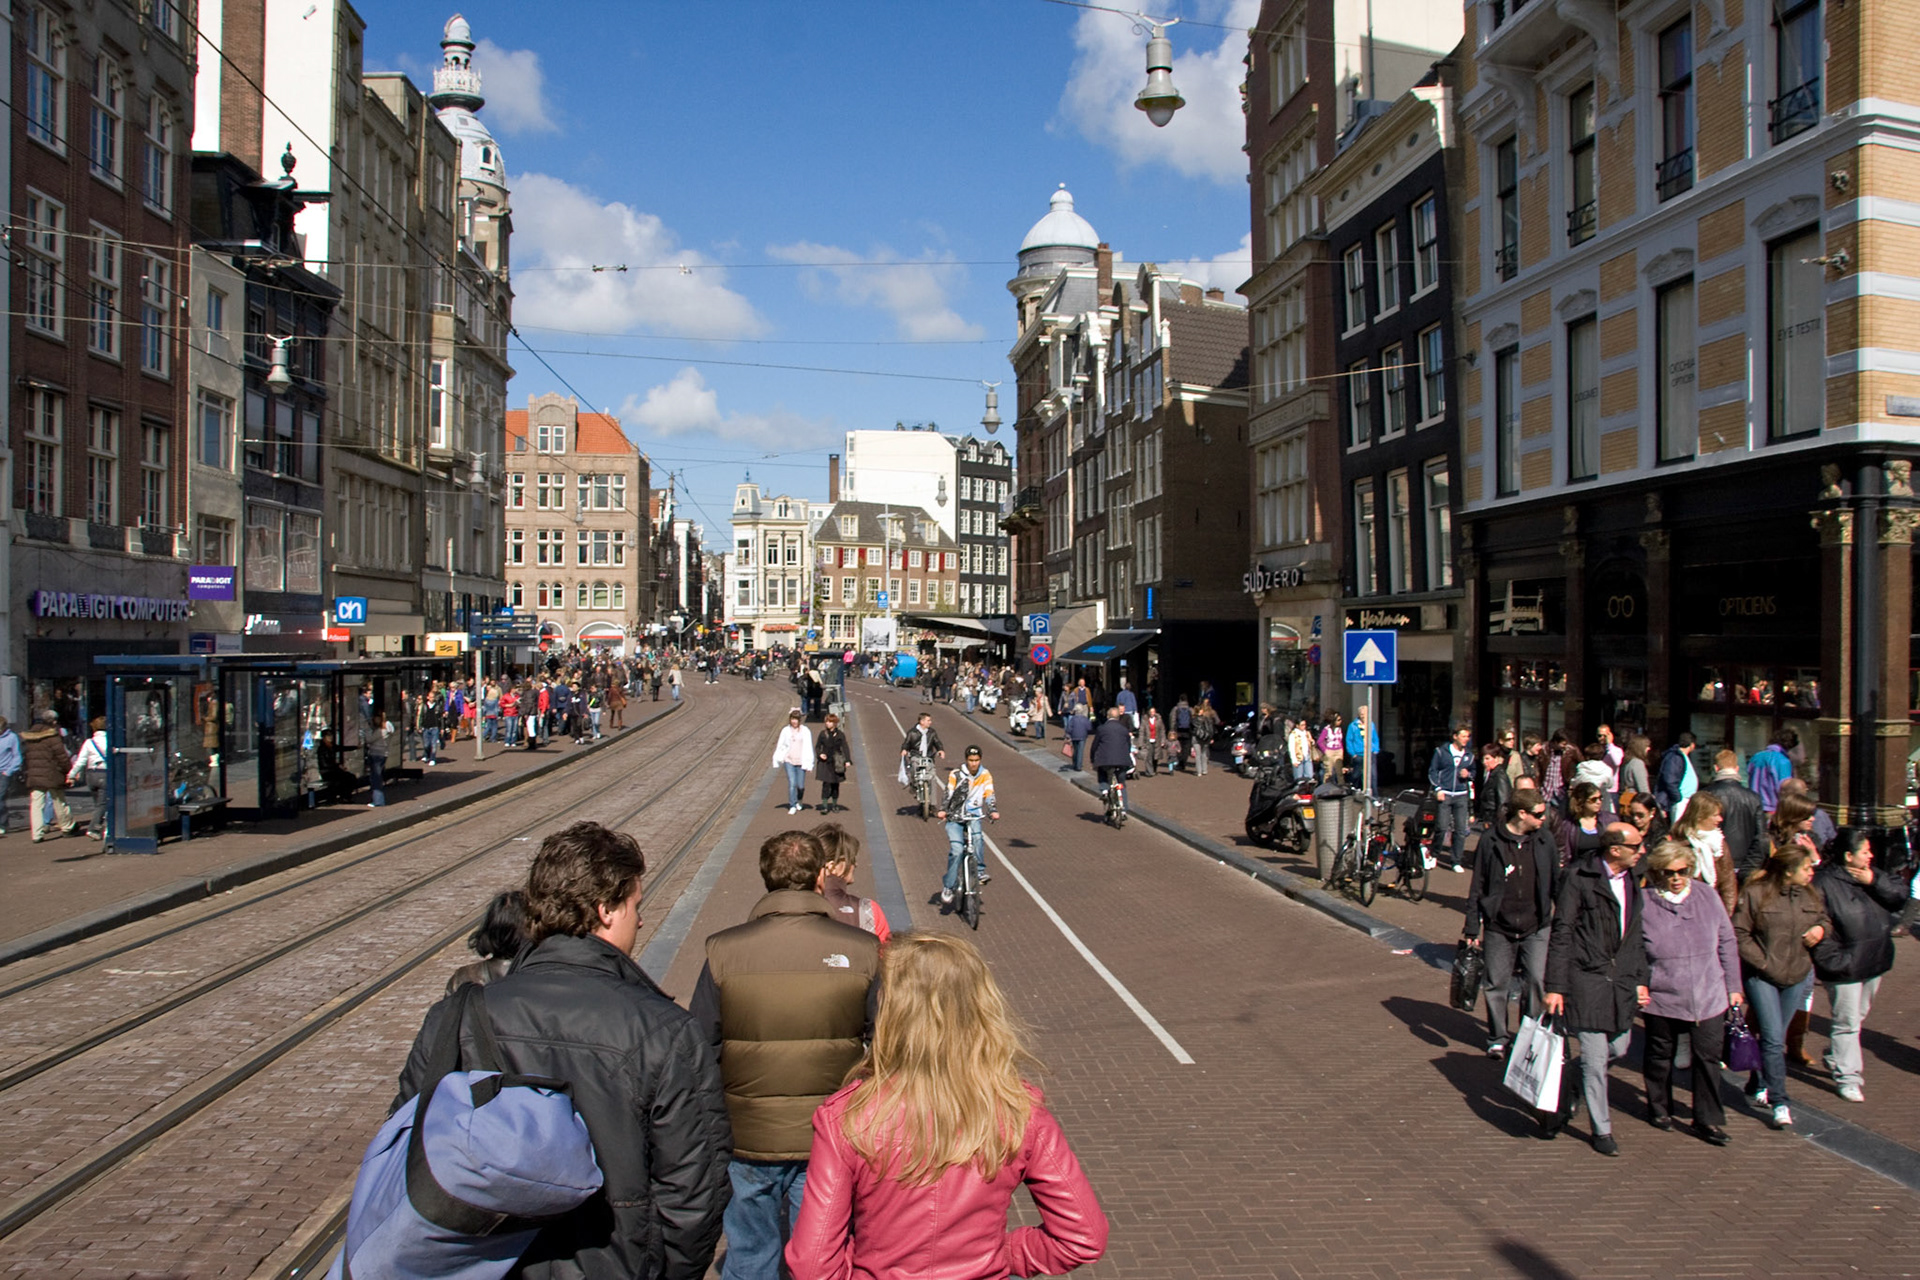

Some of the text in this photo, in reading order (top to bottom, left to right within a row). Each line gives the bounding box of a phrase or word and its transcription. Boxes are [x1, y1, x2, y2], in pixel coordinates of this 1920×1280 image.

[39, 590, 190, 622] PARADIGIT COMPUTERS
[1718, 595, 1777, 616] OPTICIENS
[1036, 620, 1046, 632] P
